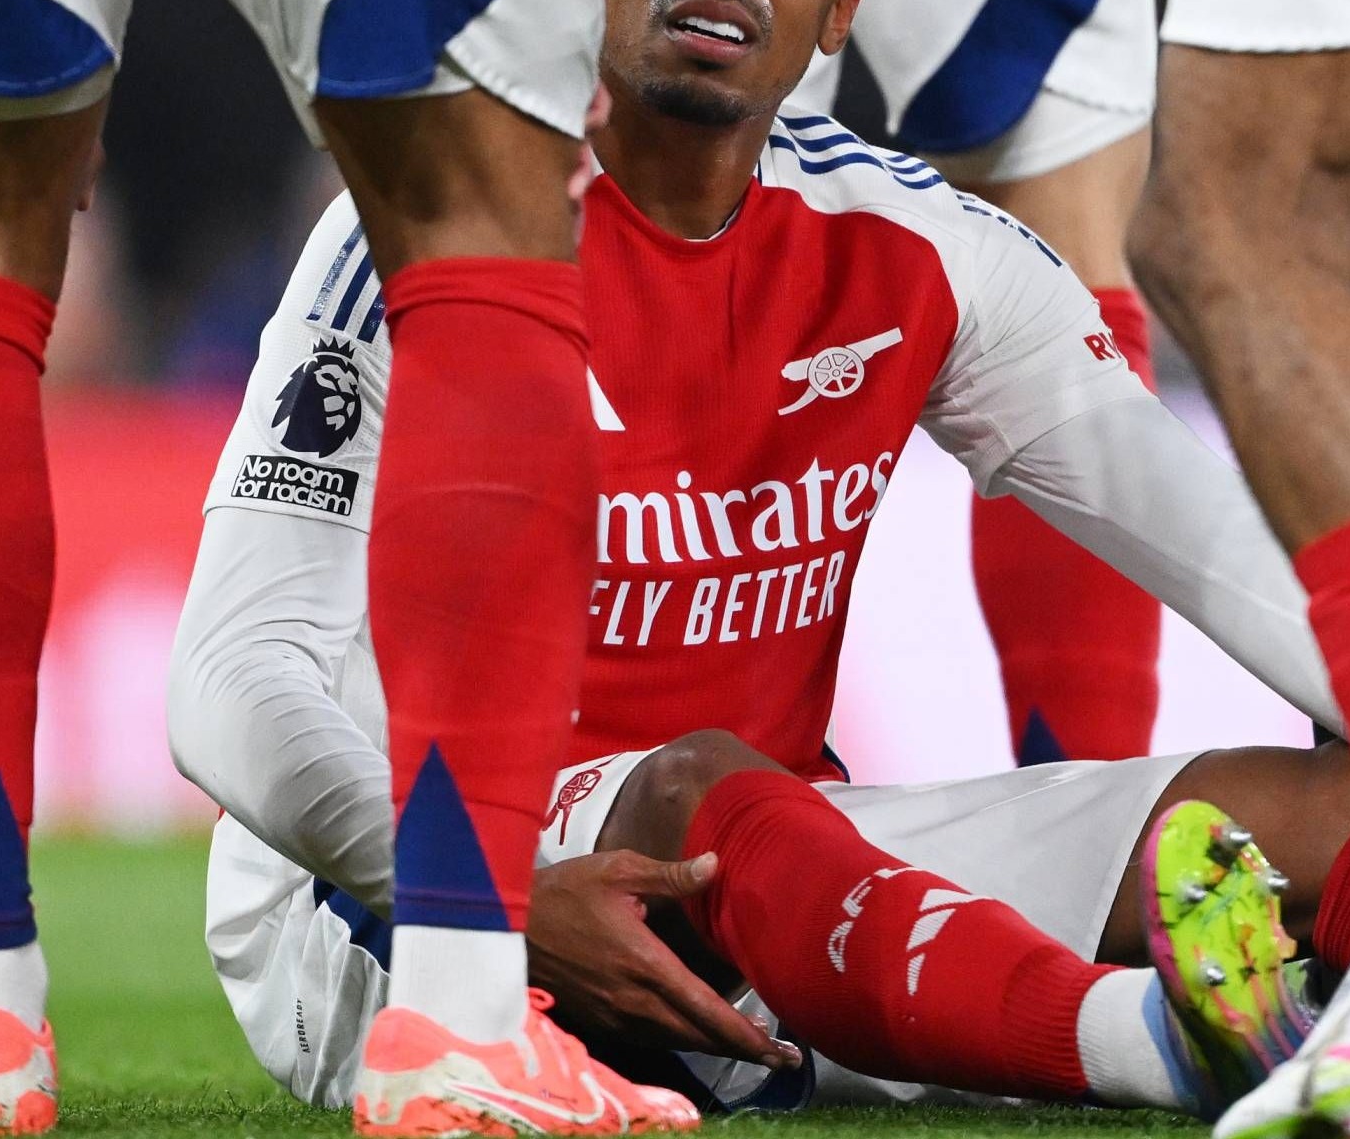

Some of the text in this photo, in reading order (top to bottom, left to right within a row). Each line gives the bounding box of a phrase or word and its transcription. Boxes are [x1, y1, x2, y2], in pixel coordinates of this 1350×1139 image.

[232, 475, 352, 516] for racism
[239, 456, 344, 493] No room
[596, 451, 893, 564] mirates
[682, 550, 847, 647] BETTER
